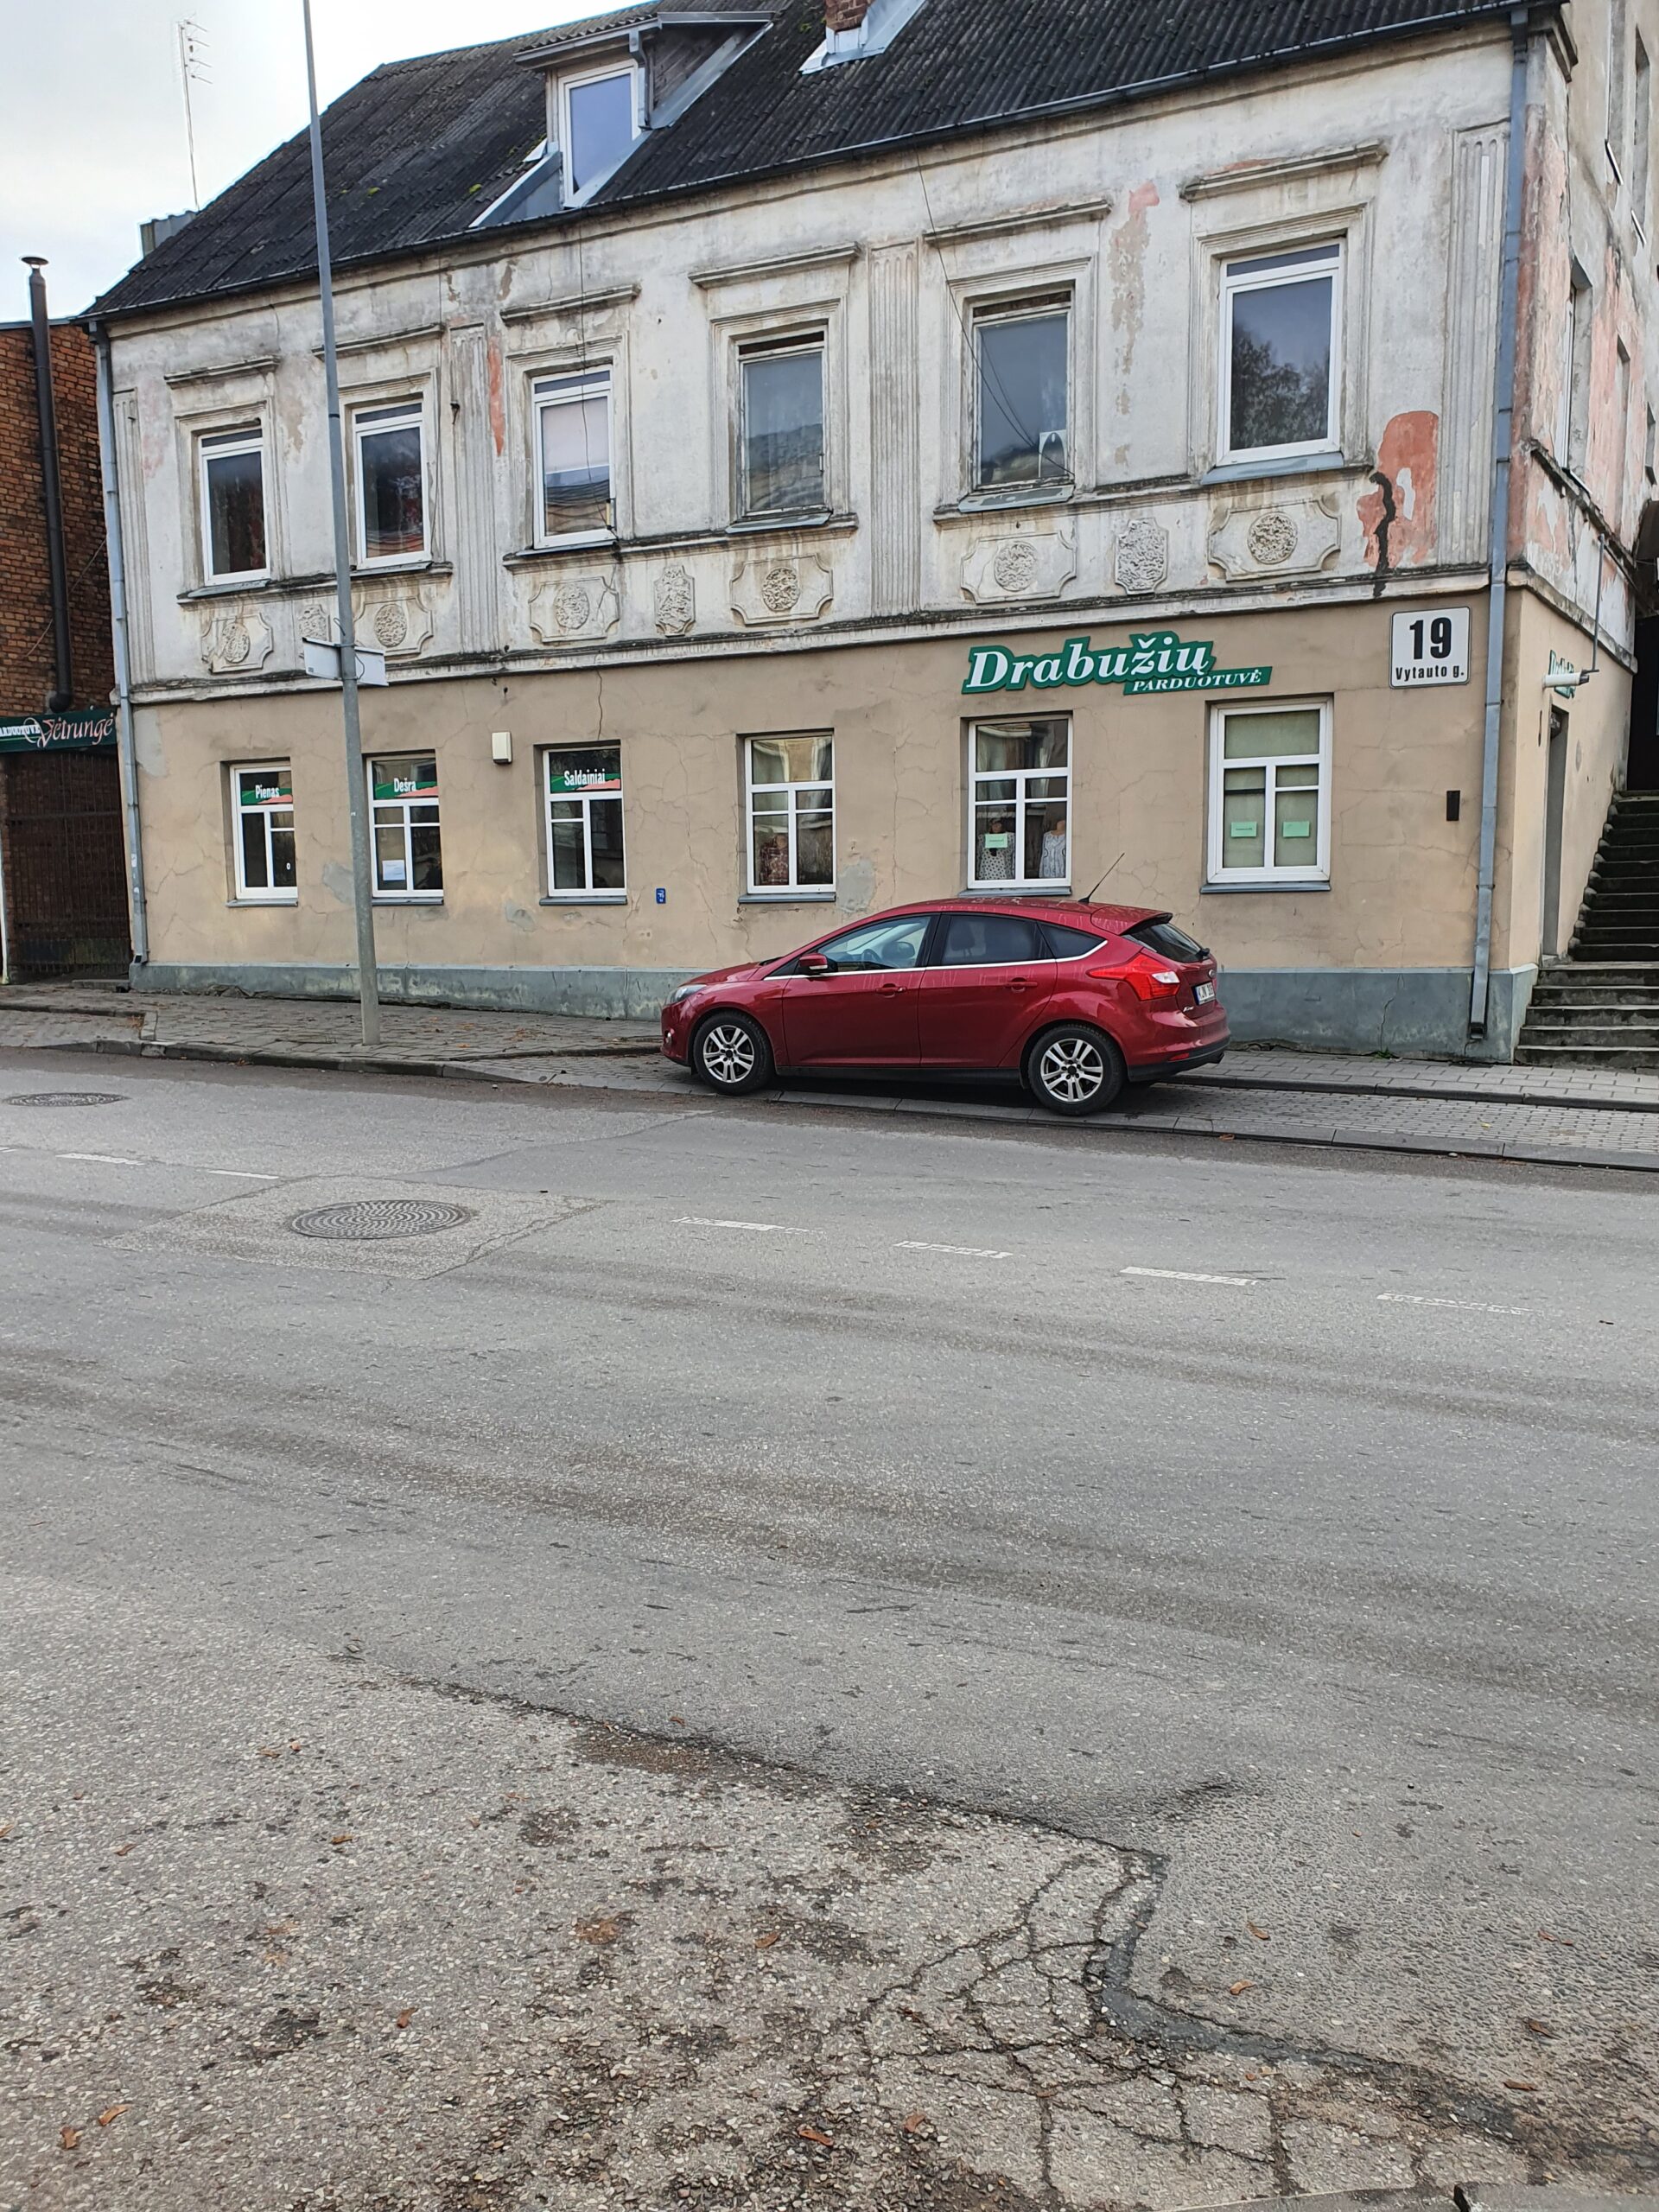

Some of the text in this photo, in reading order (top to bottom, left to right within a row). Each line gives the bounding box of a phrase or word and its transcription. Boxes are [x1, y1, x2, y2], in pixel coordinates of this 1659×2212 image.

[1408, 617, 1452, 660] 19
[965, 637, 1210, 688] Drabužių
[1132, 669, 1262, 692] PARDUOTUVĖ
[1395, 664, 1465, 682] Vytauto g.
[393, 778, 416, 792] Dešra
[563, 767, 606, 786] Saldainiai
[255, 785, 280, 798] Pienas
